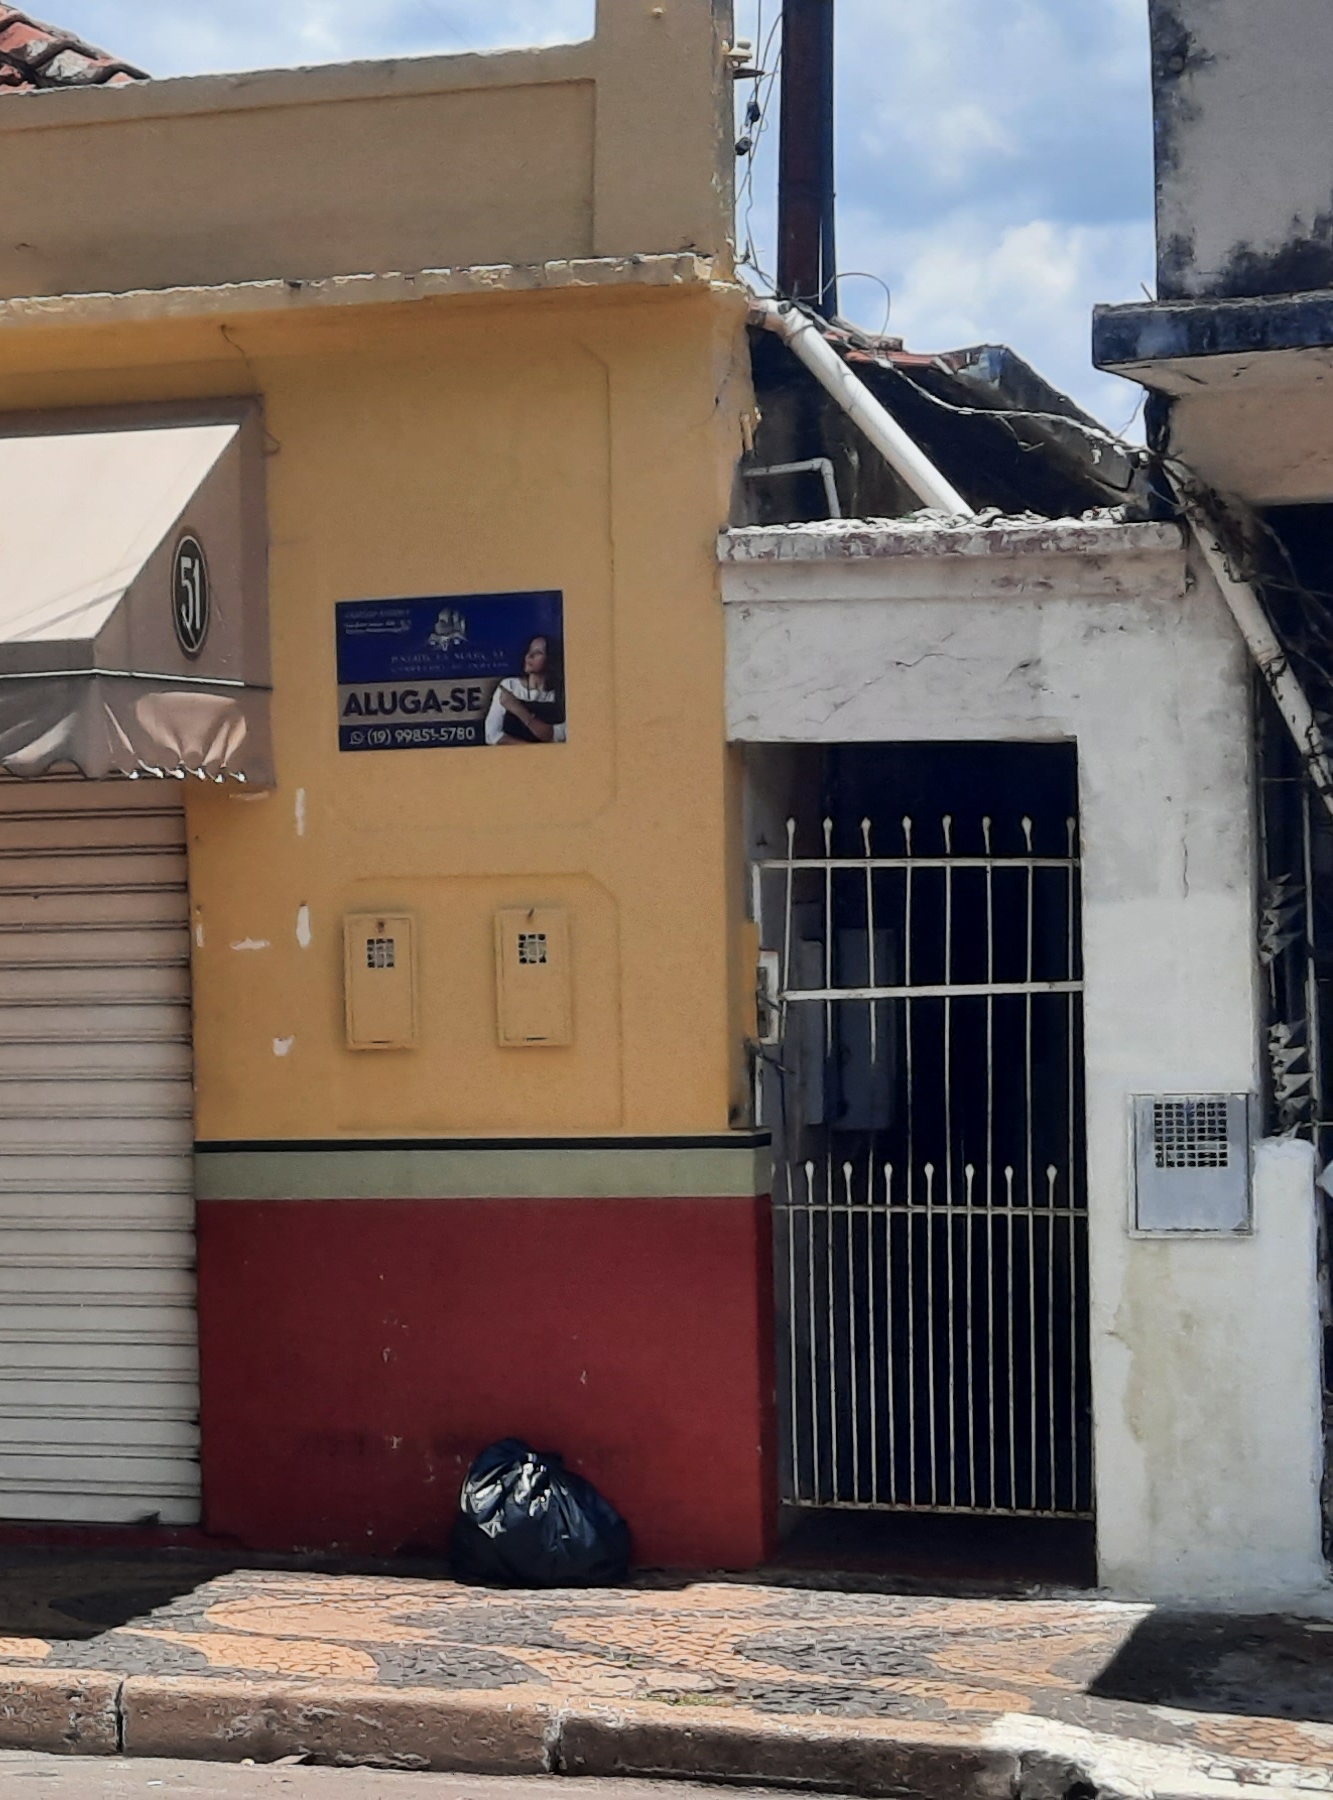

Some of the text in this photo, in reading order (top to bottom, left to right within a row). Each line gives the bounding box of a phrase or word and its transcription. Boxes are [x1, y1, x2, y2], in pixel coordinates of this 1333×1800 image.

[179, 555, 202, 632] 51
[342, 686, 483, 718] ALUGA-SE
[367, 727, 392, 746] (19)
